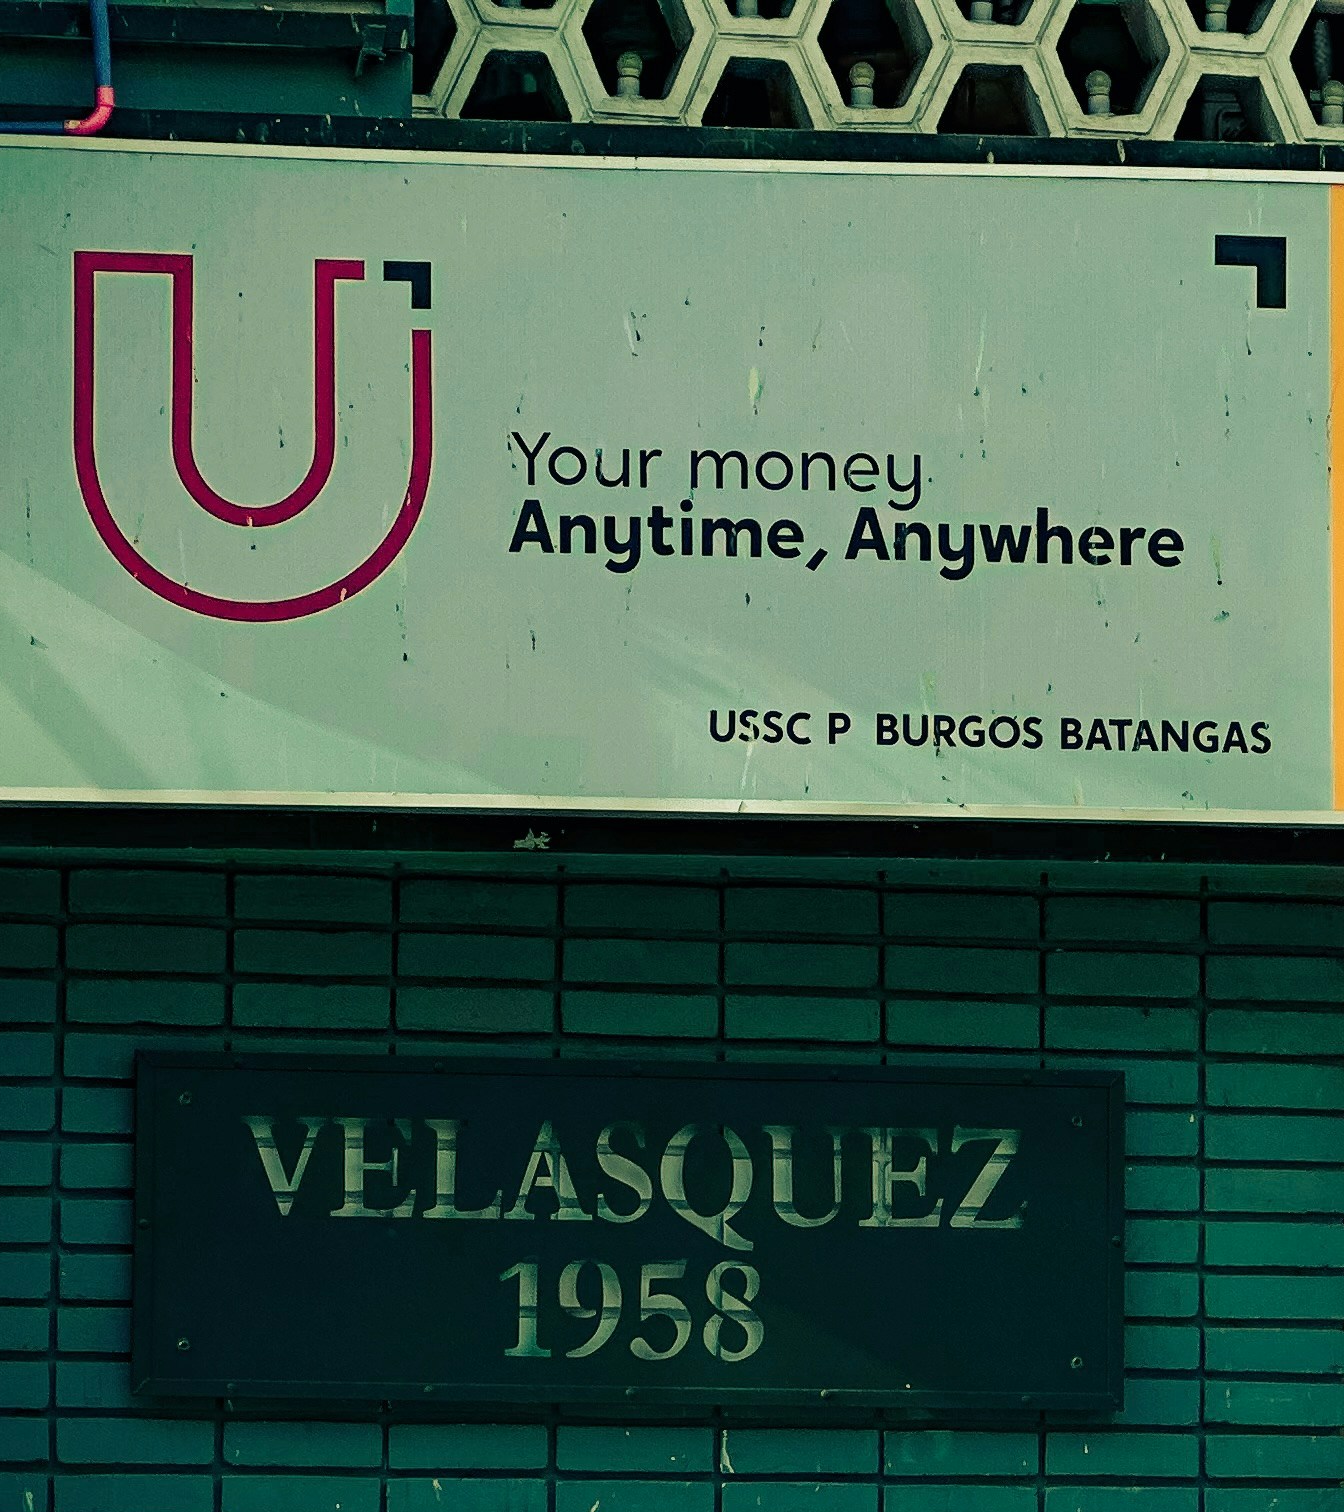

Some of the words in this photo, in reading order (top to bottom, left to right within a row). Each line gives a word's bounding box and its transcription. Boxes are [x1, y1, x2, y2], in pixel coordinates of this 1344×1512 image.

[510, 431, 663, 488] Your
[690, 448, 925, 510] money
[508, 499, 829, 575] Anytime,
[845, 507, 1186, 585] Anywhere
[708, 709, 813, 747] USSC
[827, 712, 851, 747] P
[874, 713, 1046, 752] BURGOS
[1059, 717, 1272, 756] BATANGAS
[241, 1114, 1030, 1252] VELASQUEZ
[498, 1257, 766, 1363] 1958
